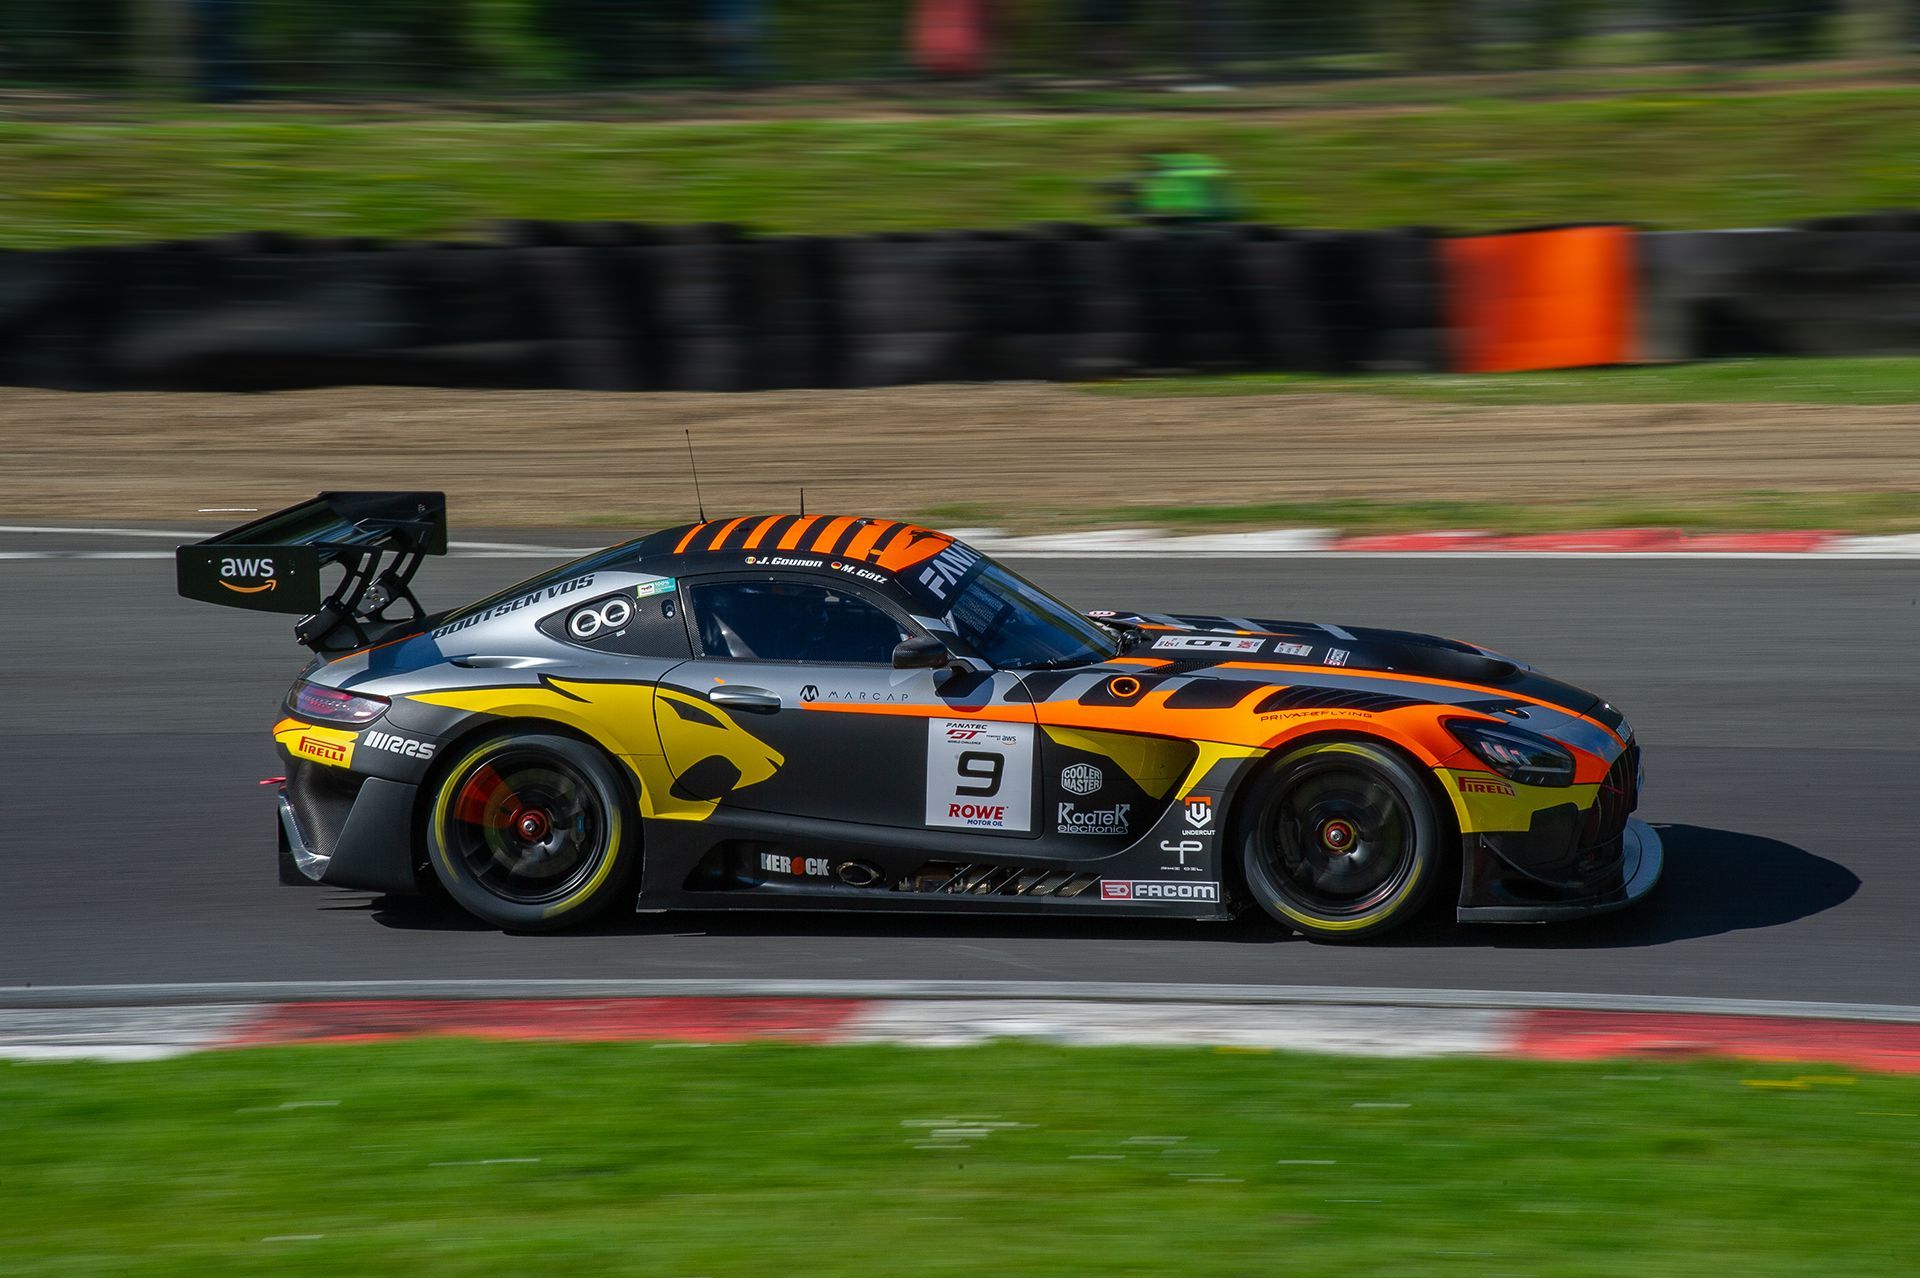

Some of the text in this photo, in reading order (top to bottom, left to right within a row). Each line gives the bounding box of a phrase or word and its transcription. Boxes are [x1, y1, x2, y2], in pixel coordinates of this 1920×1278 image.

[220, 557, 274, 577] aws
[431, 590, 543, 641] BOUTSEN
[549, 574, 596, 598] VOS
[828, 691, 909, 701] MARCAP
[1260, 711, 1373, 722] PRIVATEFLYING
[946, 722, 988, 730] FANATEC
[299, 735, 347, 762] PIRELLI
[955, 751, 1005, 797] 9
[1063, 765, 1100, 780] COOLER
[1063, 777, 1100, 793] MASTER
[1458, 776, 1515, 796] PIRELLI
[948, 803, 1005, 820] ROWE
[1135, 884, 1215, 899] FACOM
